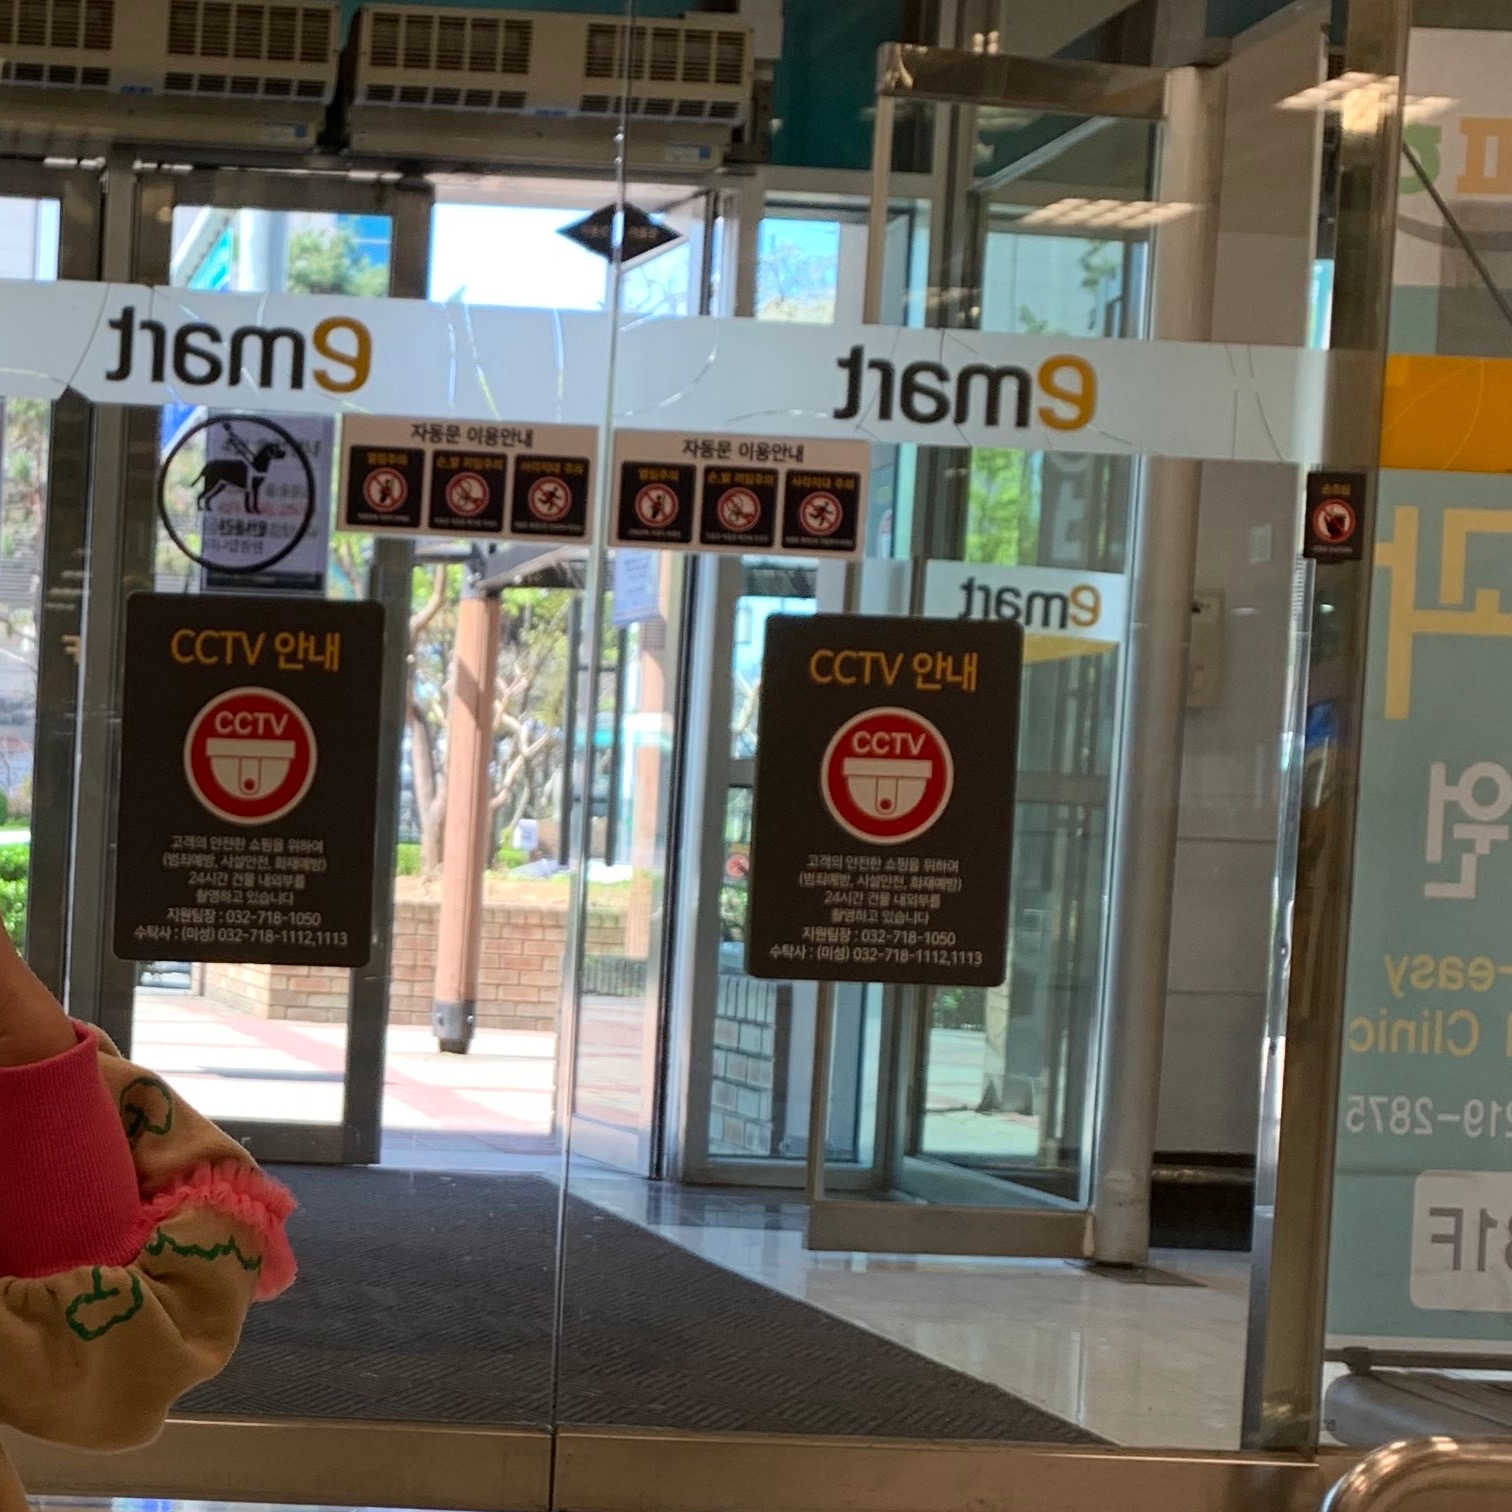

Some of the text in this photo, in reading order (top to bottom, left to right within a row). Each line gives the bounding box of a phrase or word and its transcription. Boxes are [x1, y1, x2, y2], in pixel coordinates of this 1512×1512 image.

[410, 423, 534, 449] 자동문 이용안내
[682, 439, 805, 463] 자동문 이용안내
[171, 628, 341, 672] CCTV 안내
[809, 649, 978, 693] CCTV 안내
[215, 710, 288, 736] CCTV
[852, 730, 927, 757] CCTV
[171, 835, 324, 853] 고객의 안전한 쇼핑을 위하여
[807, 854, 959, 874] 고객의 안전한 쇼핑을 위하여
[189, 871, 227, 886] 24시간
[231, 872, 255, 887] 건물
[195, 888, 294, 905] 촬영하고 있습니다
[824, 890, 863, 905] 24시간
[867, 892, 891, 907] 건물
[168, 908, 216, 924] 지원팀장
[226, 909, 322, 926] 032-718-1050
[831, 908, 929, 925] 촬영하고 있습니다
[802, 927, 852, 943] 지원팀장
[861, 929, 956, 946] 032-718-1050
